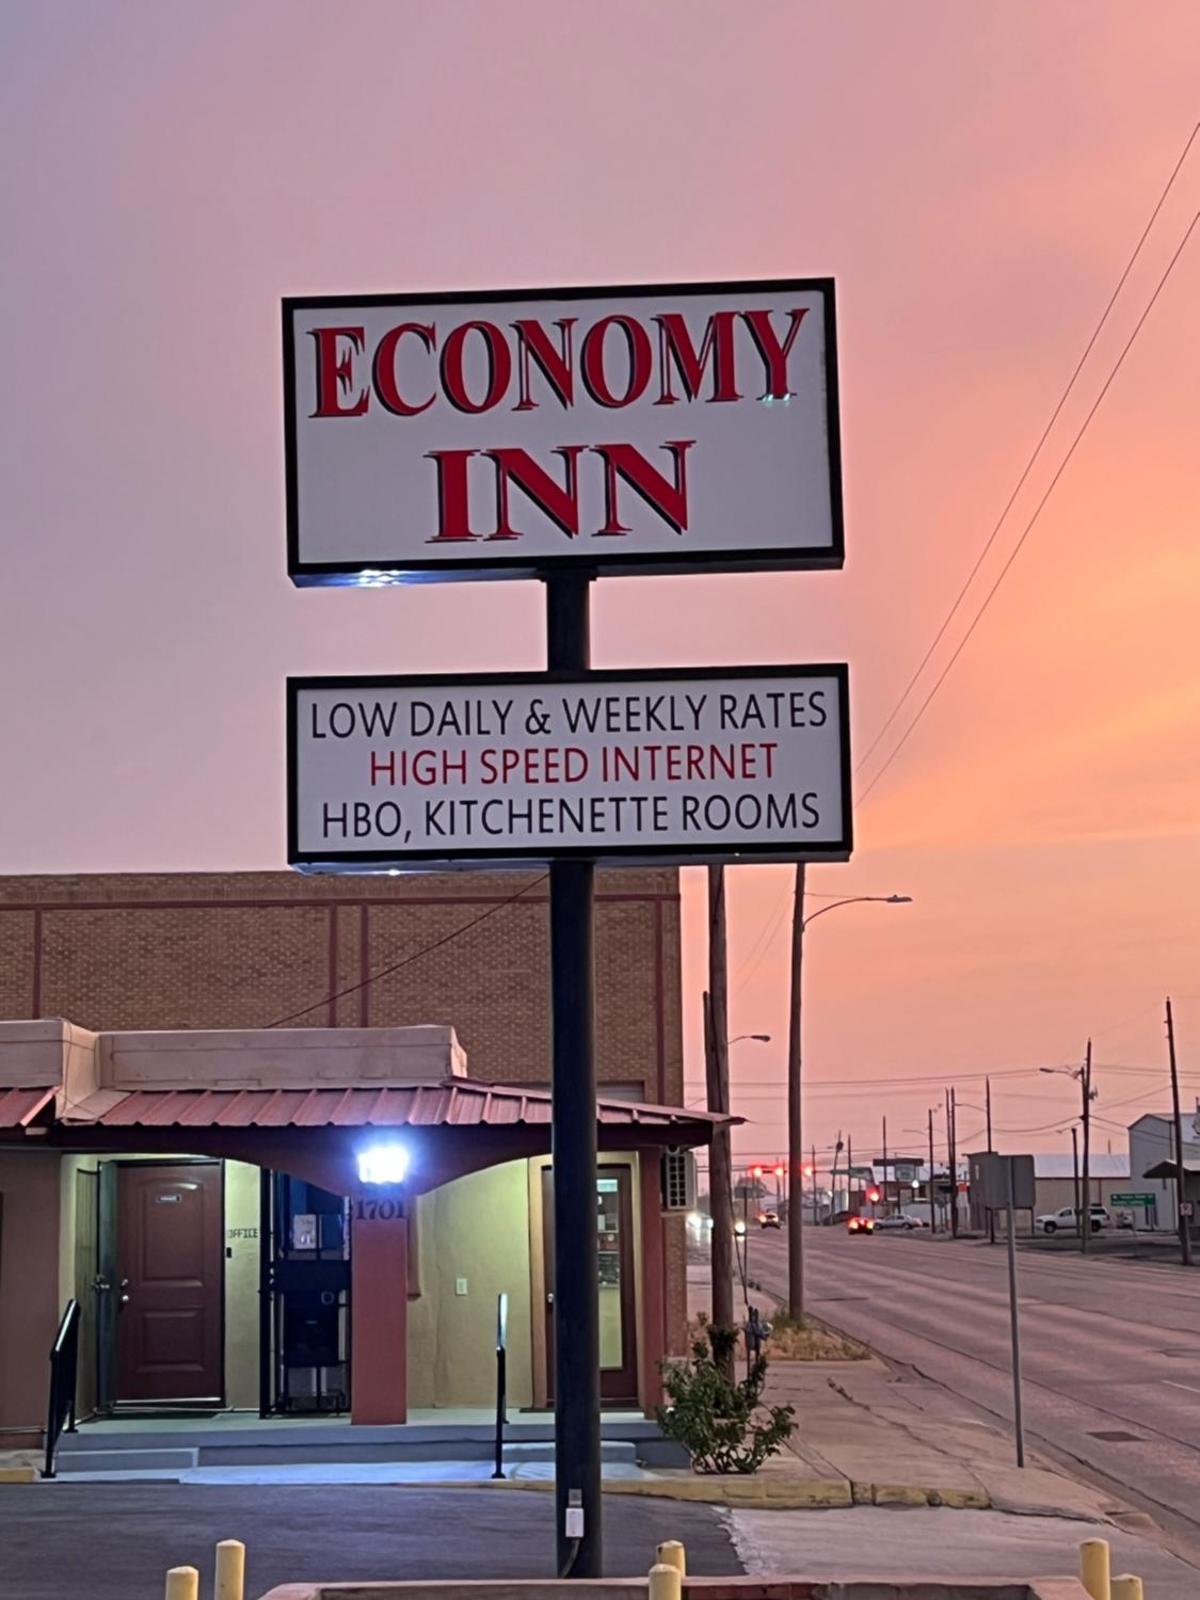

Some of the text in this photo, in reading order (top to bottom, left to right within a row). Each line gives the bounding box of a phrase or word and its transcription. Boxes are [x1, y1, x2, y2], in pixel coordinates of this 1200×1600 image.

[307, 308, 810, 418] ECONOMY
[424, 440, 697, 543] INN
[312, 691, 827, 738] LOW DAILY & WEEKLY RATES
[371, 743, 778, 787] HIGH SPEED INTERNET
[323, 793, 820, 844] HBO, KITCHENETTE ROOMS
[355, 1199, 406, 1220] 1701
